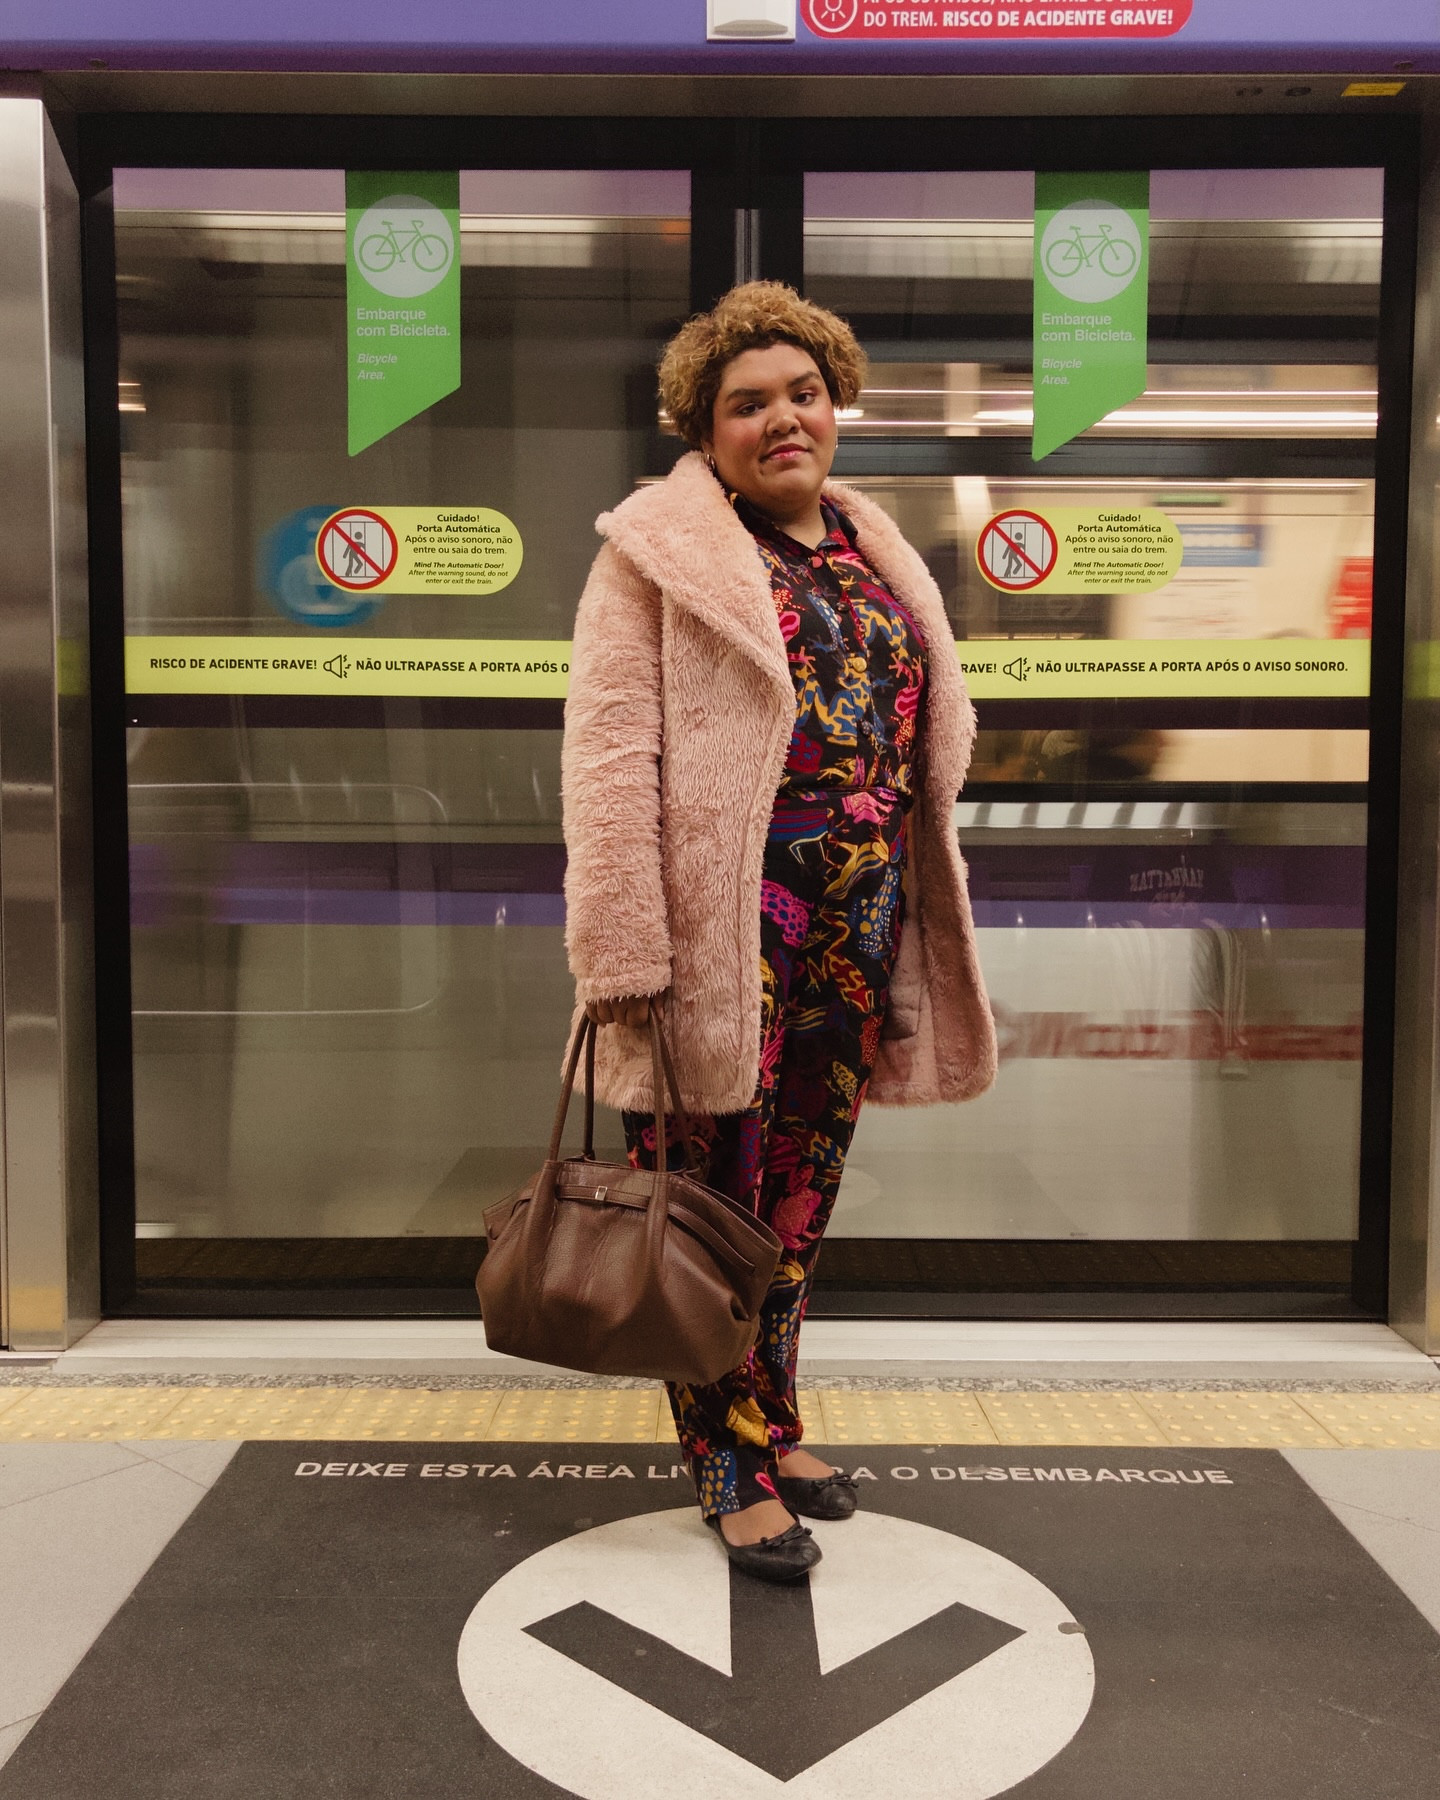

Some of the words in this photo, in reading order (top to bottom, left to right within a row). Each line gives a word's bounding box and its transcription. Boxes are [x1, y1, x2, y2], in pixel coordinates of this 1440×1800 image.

[864, 11, 886, 27] DO
[891, 11, 938, 27] TREM.
[942, 10, 993, 27] RISCO
[997, 11, 1020, 26] DE
[1024, 10, 1106, 26] ACIDENTE
[1110, 10, 1173, 25] GRAVE!
[356, 308, 426, 323] Embarque
[1042, 313, 1111, 328] Embarque
[356, 326, 385, 336] com
[390, 324, 450, 336] Bicicleta.
[1042, 332, 1070, 341] com
[1075, 330, 1135, 341] Bicicleta.
[357, 354, 397, 366] Bicycle
[1042, 359, 1082, 371] Bicycle
[358, 370, 385, 380] Area.
[1042, 375, 1069, 384] Area.
[437, 514, 480, 523] Cuidado!
[1098, 514, 1141, 522] Cuidado!
[417, 525, 442, 533] Porta
[445, 525, 501, 533] Automática
[1077, 525, 1103, 533] Porta
[1106, 525, 1161, 533] Automática
[405, 535, 427, 545] Após
[437, 535, 459, 543] aviso
[461, 536, 494, 545] sonoro,
[496, 536, 513, 544] não
[1065, 535, 1087, 545] Após
[1098, 535, 1120, 543] aviso
[1122, 536, 1154, 544] sonoro,
[1157, 535, 1174, 543] não
[413, 546, 436, 554] entre
[451, 546, 469, 554] saia
[471, 546, 482, 554] do
[1073, 546, 1096, 554] entre
[1098, 546, 1109, 554] ou
[1112, 546, 1129, 554] saia
[1131, 545, 1142, 554] do
[1145, 546, 1167, 554] trem.
[150, 659, 187, 669] RISCO
[190, 659, 206, 669] DE
[209, 659, 269, 670] ACIDENTE
[272, 659, 317, 670] GRAVE!
[356, 657, 382, 671] NÃO
[385, 660, 465, 672] ULTRAPASSE
[468, 661, 478, 672] A
[481, 661, 521, 673] PORTA
[524, 659, 558, 673] APÓS
[561, 663, 570, 673] O
[961, 663, 997, 674] RAVE!
[1036, 660, 1062, 673] NÃO
[1065, 662, 1145, 673] ULTRAPASSE
[1149, 662, 1158, 672] A
[1161, 662, 1202, 672] PORTA
[1205, 659, 1239, 672] APÓS
[1243, 661, 1251, 672] O
[1254, 661, 1292, 672] AVISO
[1294, 661, 1348, 672] SONORO.
[295, 1462, 408, 1477] DEIXE
[420, 1463, 518, 1478] ESTA
[527, 1461, 636, 1478] ÁREA
[890, 1466, 919, 1480] O
[931, 1466, 1234, 1484] DESEMBARQUE
